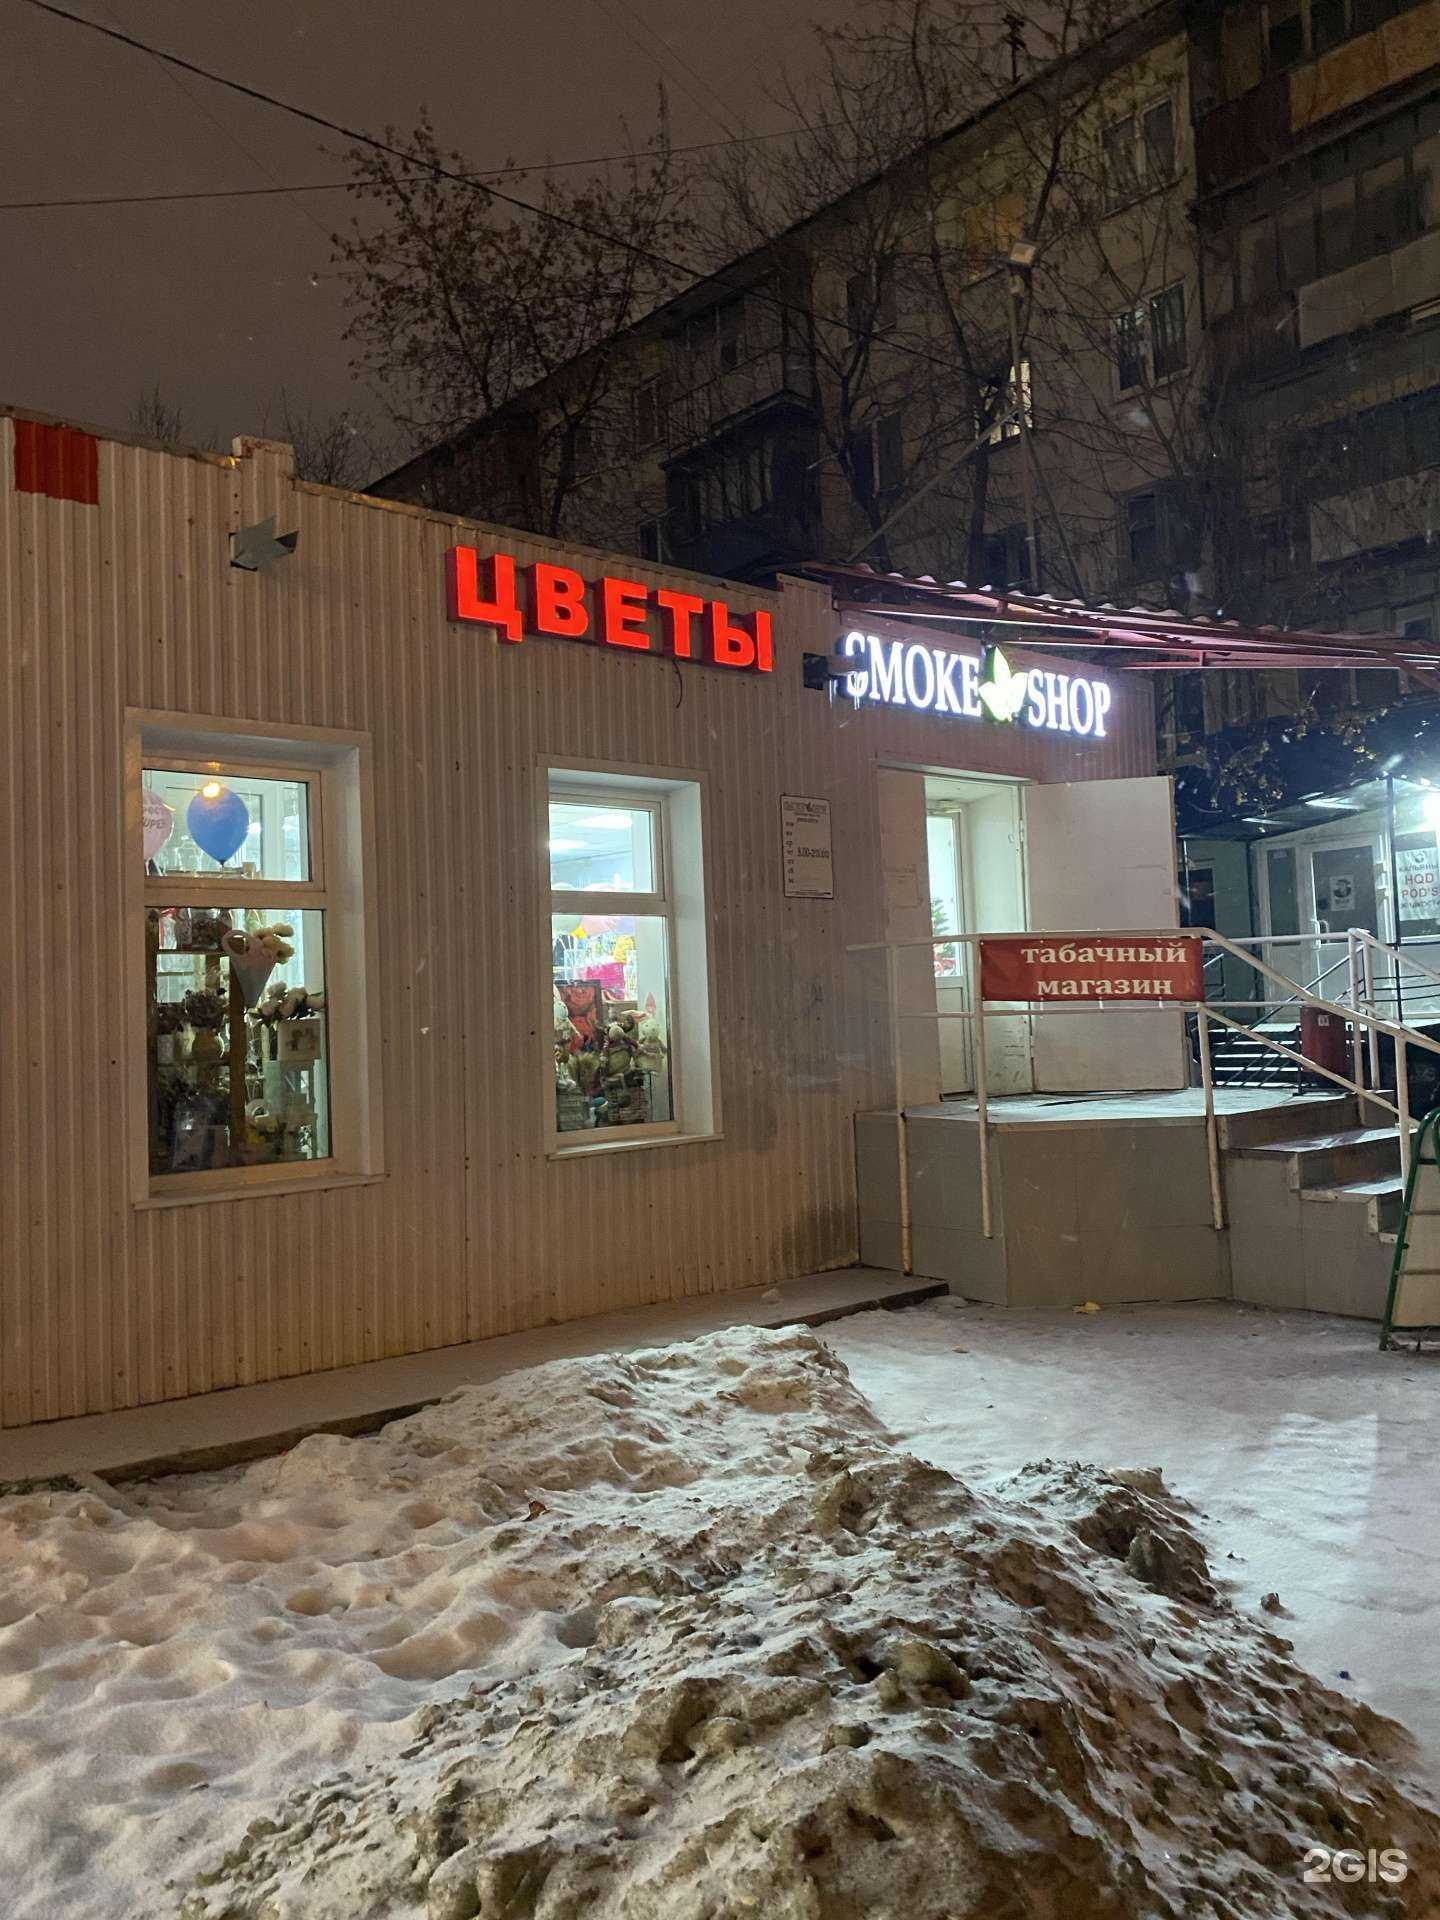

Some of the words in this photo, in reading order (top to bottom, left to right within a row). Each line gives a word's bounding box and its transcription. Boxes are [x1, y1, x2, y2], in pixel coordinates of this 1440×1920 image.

[453, 544, 774, 673] ЦВЕТЫ
[845, 631, 982, 718] SMOKE
[1025, 668, 1111, 738] SHOP
[1405, 873, 1434, 885] HQD
[1020, 942, 1187, 964] табачный
[1037, 979, 1174, 996] магазин
